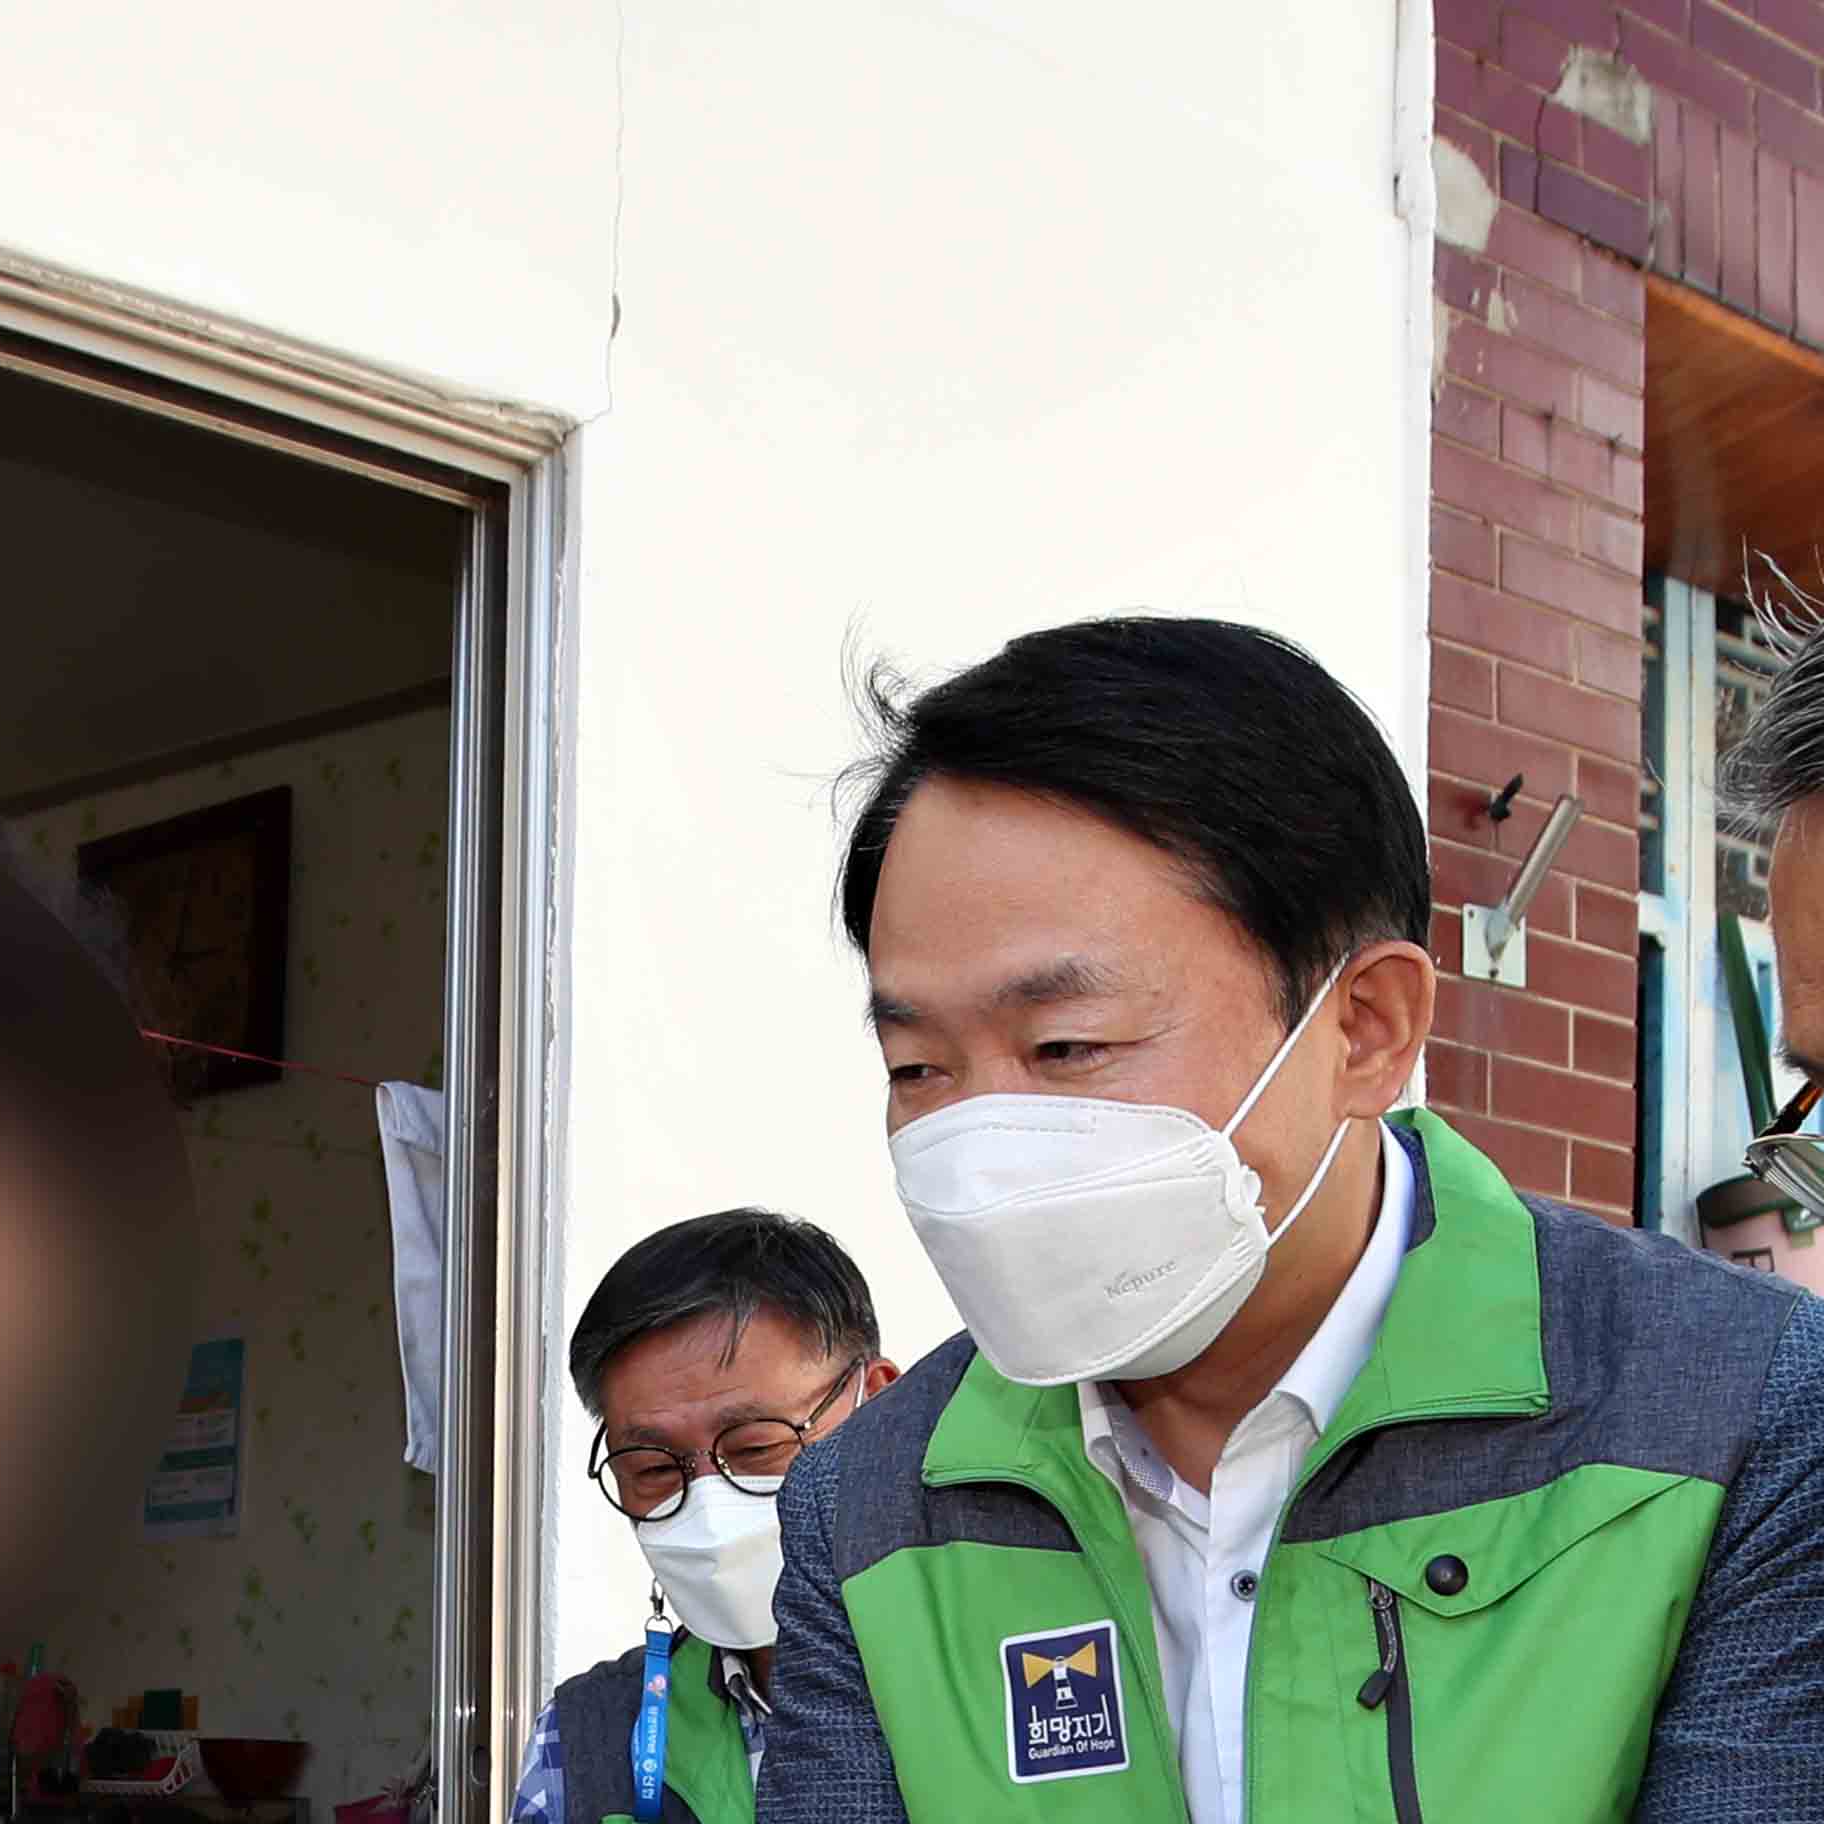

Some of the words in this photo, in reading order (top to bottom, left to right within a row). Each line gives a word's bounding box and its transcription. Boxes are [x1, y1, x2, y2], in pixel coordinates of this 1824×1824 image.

[1028, 1694, 1112, 1745] 희망지기
[1028, 1744, 1074, 1760] Guardian
[1090, 1739, 1116, 1752] Hope
